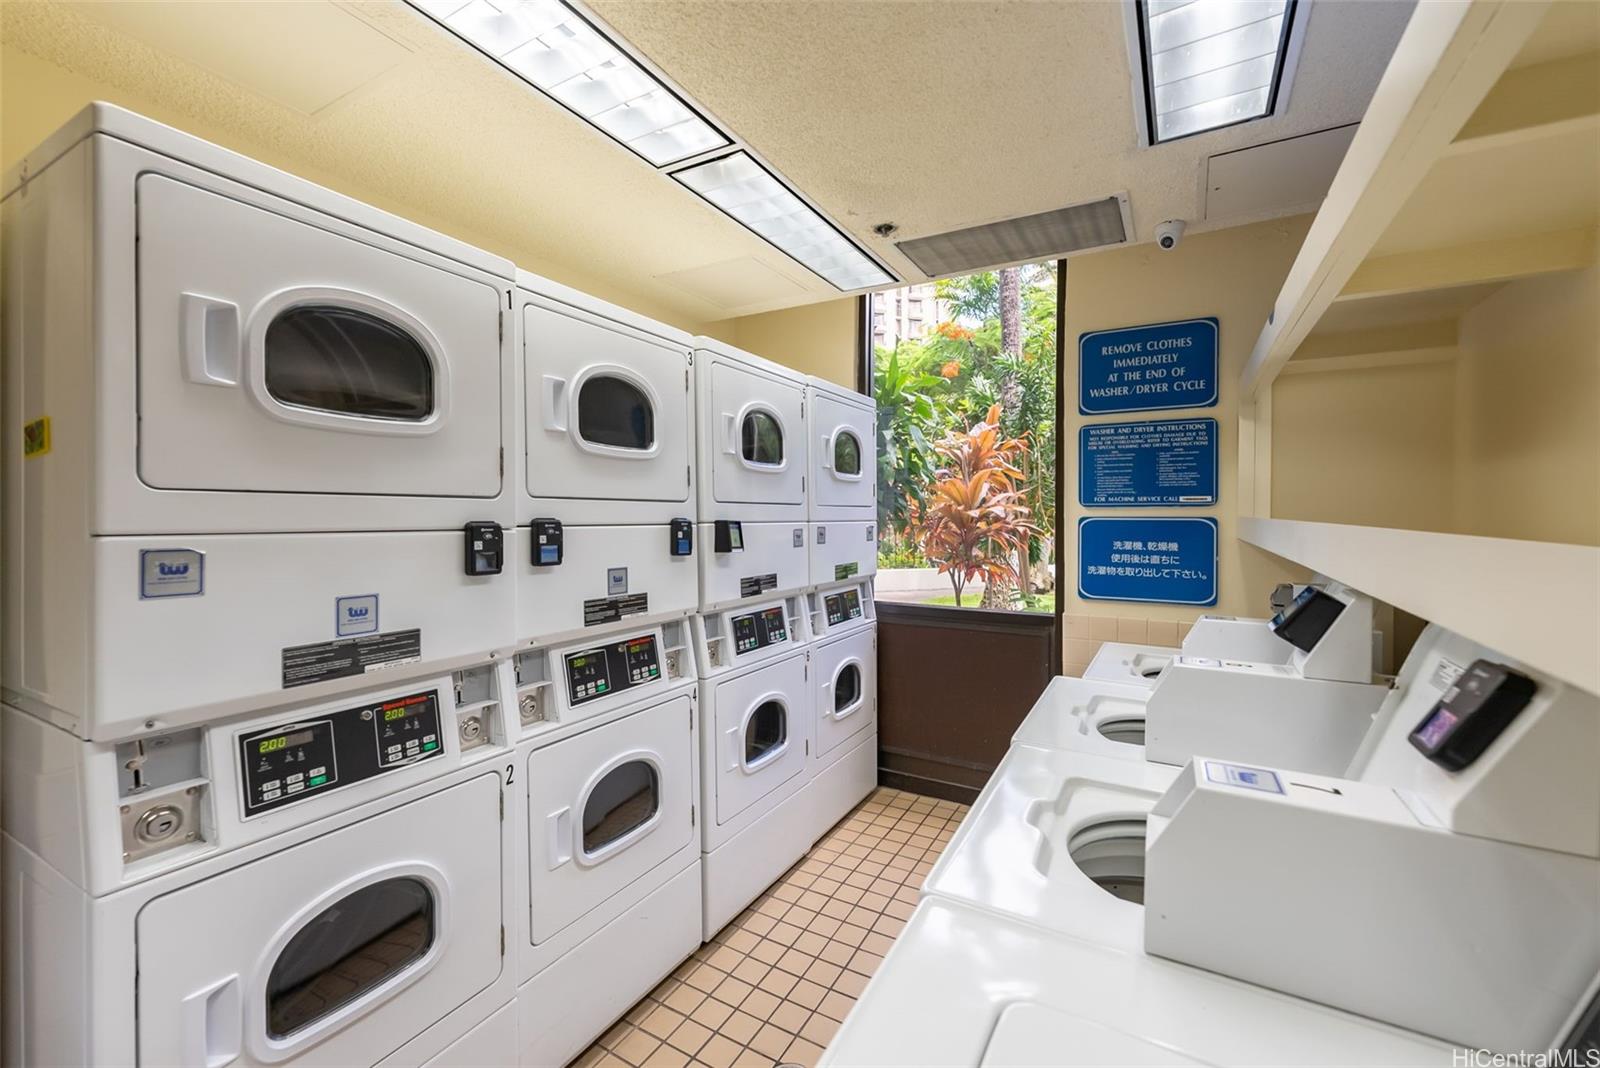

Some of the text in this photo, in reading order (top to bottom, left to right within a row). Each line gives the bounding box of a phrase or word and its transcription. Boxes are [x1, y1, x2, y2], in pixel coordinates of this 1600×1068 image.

[506, 290, 512, 310] 1
[1102, 337, 1192, 356] REMOVE CLOTHES
[688, 352, 693, 366] 3
[1113, 353, 1178, 368] IMMEDIATELY
[1108, 367, 1186, 382] AT THE END OF
[1090, 380, 1206, 398] WASHER/DRYER CYCLE
[1112, 541, 1178, 552] 洗濯機、乾燥機
[1110, 554, 1180, 564] 使用後は直ちに
[1087, 566, 1208, 580] 洗濯物を取り出して下さい。
[505, 764, 514, 786] 2
